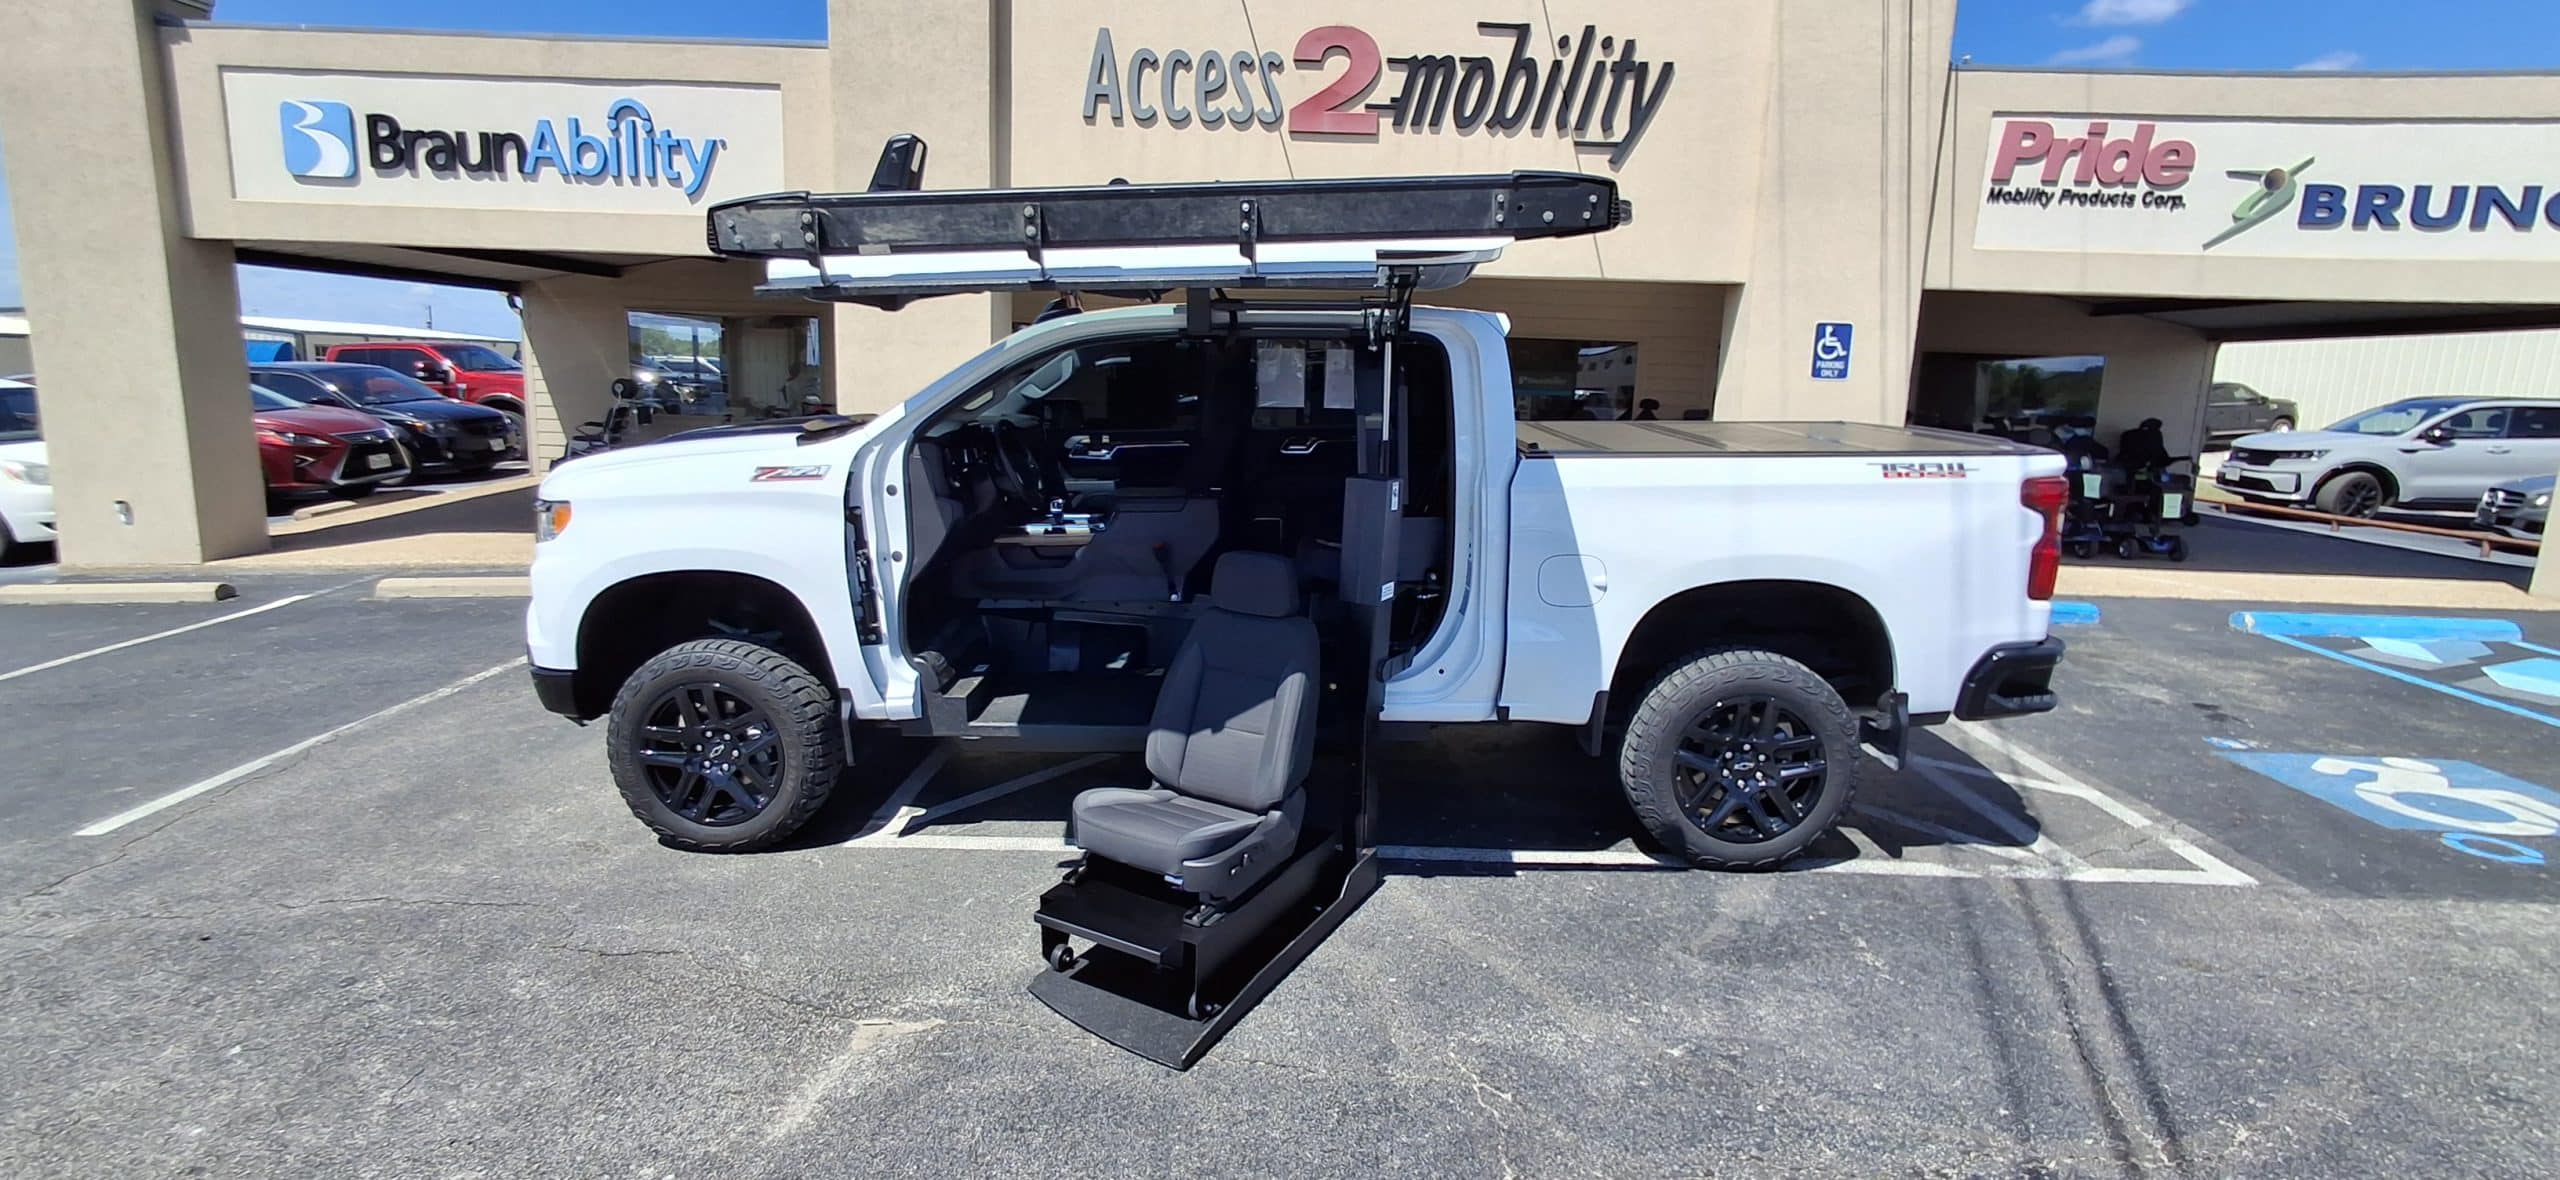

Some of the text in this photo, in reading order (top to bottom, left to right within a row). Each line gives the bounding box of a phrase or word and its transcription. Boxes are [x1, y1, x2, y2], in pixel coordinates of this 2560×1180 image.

[364, 97, 719, 197] BraunAbility
[1991, 121, 2196, 190] Pride
[1987, 187, 2187, 211] Mobility Products Corp.
